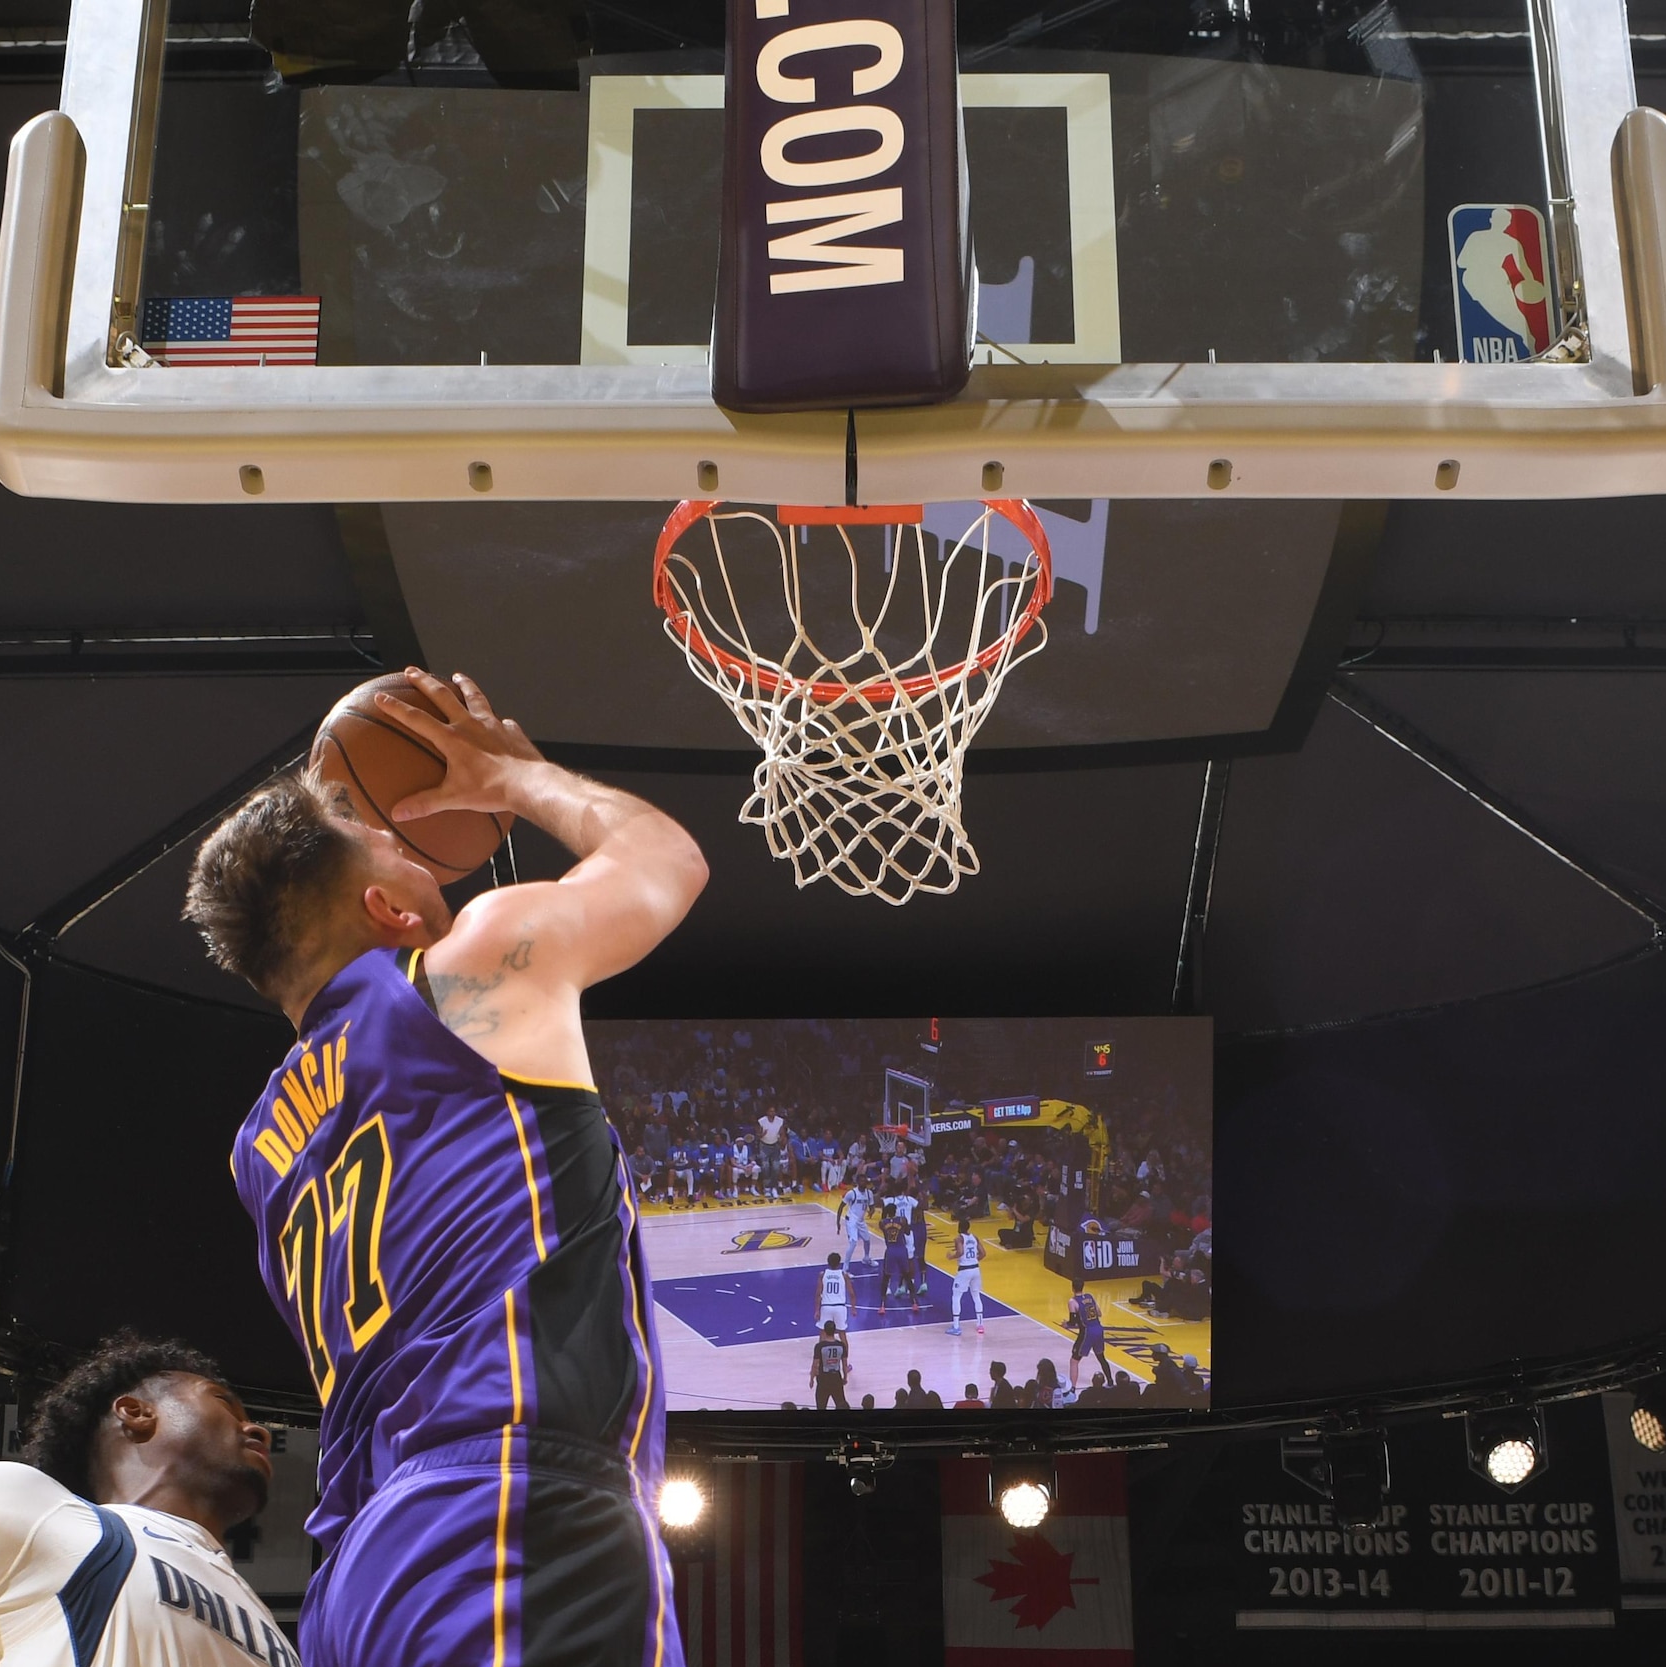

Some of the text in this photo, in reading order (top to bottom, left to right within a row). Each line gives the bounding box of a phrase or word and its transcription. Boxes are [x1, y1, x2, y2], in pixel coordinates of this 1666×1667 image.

[1473, 337, 1520, 363] NBA
[253, 1020, 352, 1179] DONČIĆ
[278, 1112, 393, 1409] 77
[1117, 1241, 1134, 1254] JOIN
[1242, 1503, 1335, 1527] STANLE
[1429, 1502, 1595, 1527] STANLEY CUP
[1243, 1529, 1412, 1557] CHAMPIONS
[1430, 1528, 1599, 1557] CHAMPIONS
[1268, 1566, 1393, 1598] 2013-14
[1459, 1566, 1578, 1598] 2011-12
